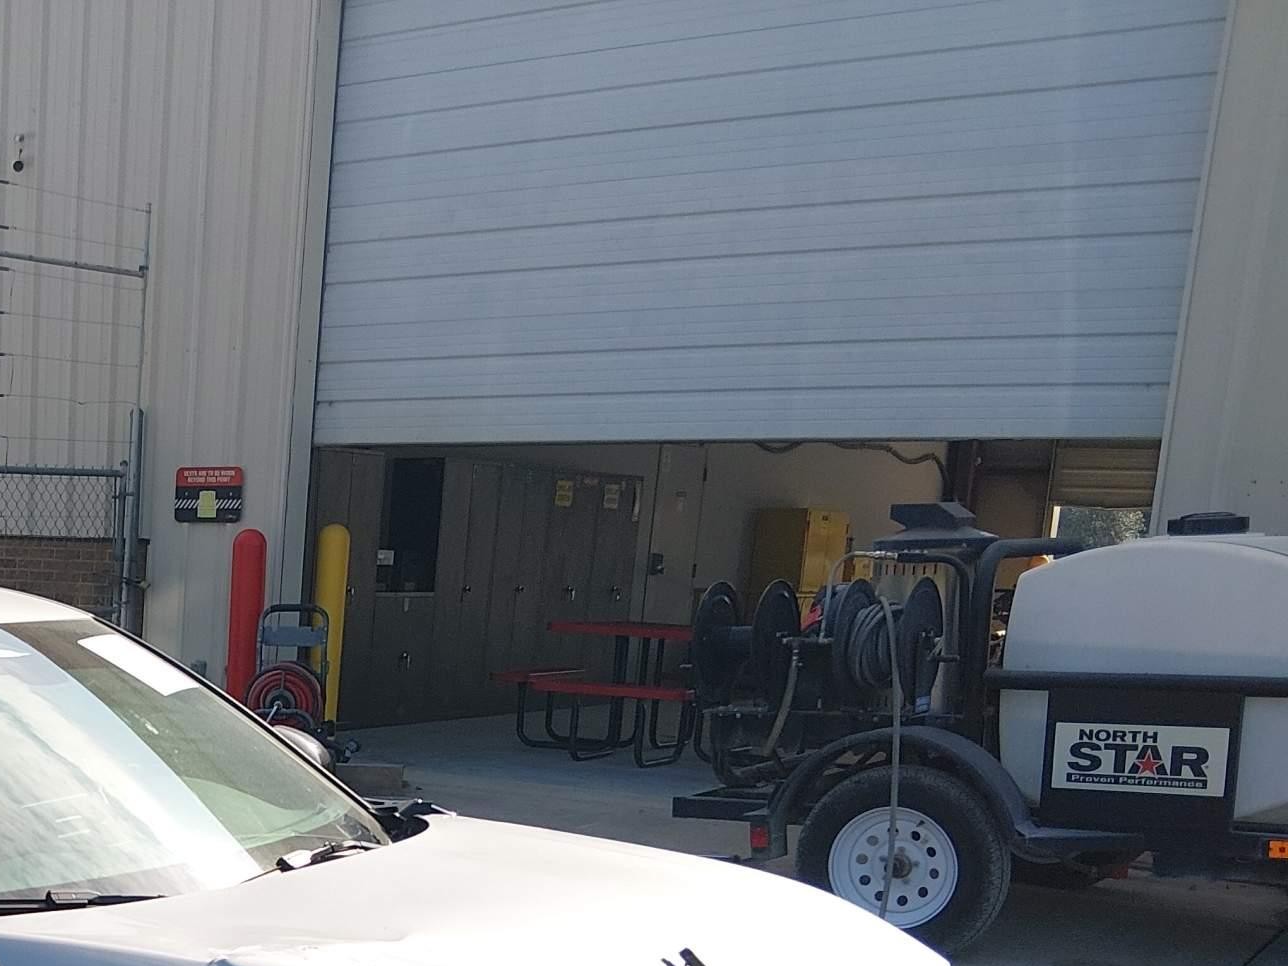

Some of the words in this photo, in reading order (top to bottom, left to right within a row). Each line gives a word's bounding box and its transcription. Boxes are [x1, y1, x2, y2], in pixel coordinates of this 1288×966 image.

[1078, 728, 1158, 743] NORTH
[1067, 741, 1209, 778] STAR
[1071, 774, 1114, 784] Proven
[1119, 776, 1203, 788] Performance
